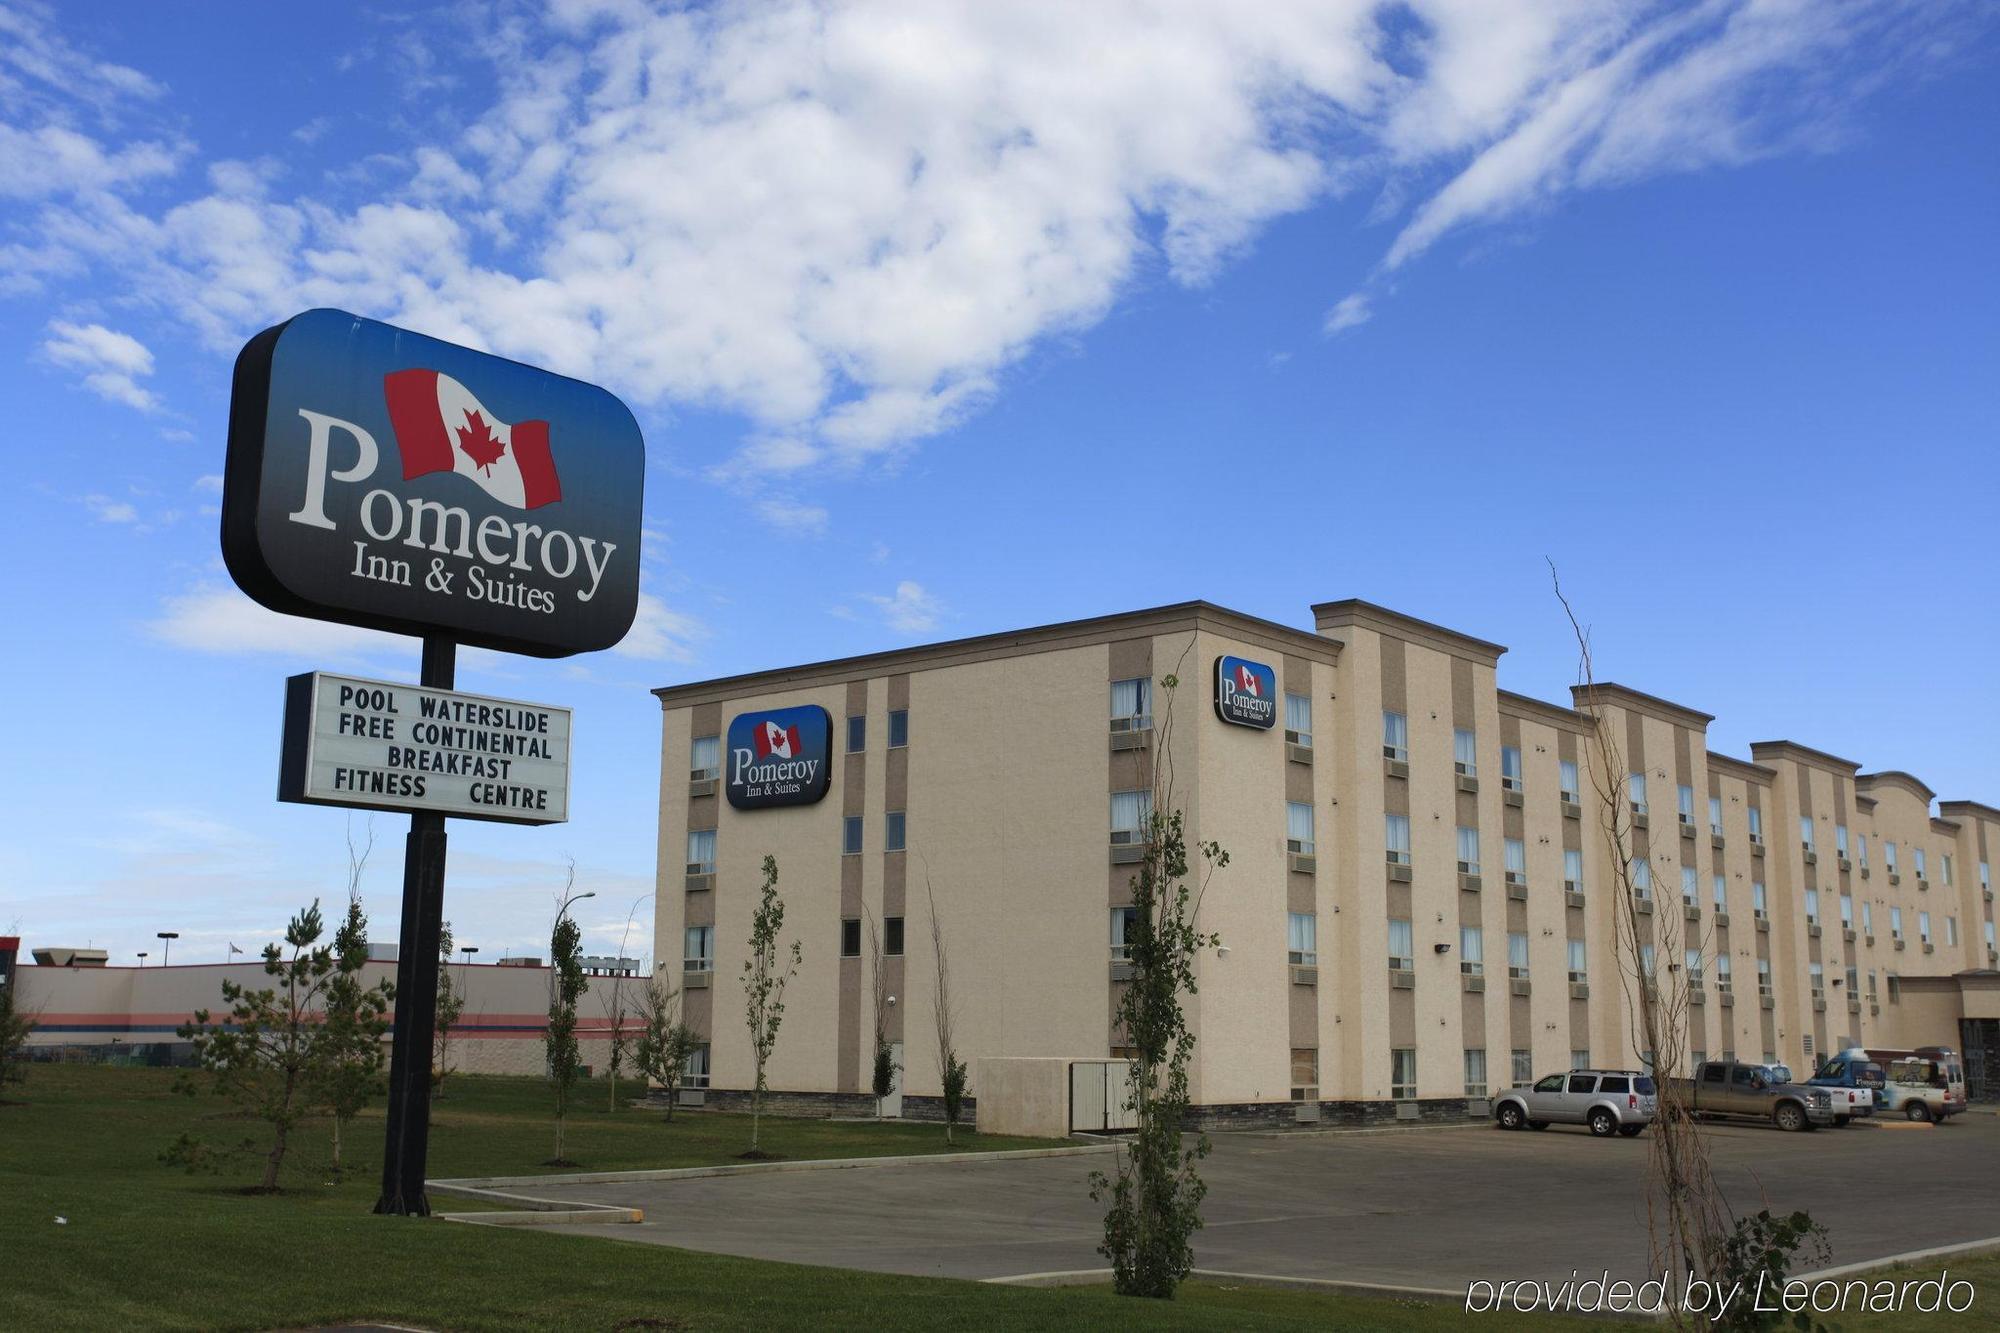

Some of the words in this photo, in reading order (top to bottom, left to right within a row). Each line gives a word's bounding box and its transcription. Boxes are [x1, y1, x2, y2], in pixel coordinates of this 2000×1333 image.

[288, 408, 618, 602] Pomeroy
[351, 540, 412, 586] Inn
[424, 557, 453, 595] &
[465, 565, 556, 614] Suites
[340, 685, 399, 714] POOL
[419, 696, 549, 734] WATERSLIDE
[1223, 678, 1272, 718] Pomeroy
[339, 713, 395, 740] FREE
[412, 722, 552, 760] CONTINENTAL
[387, 745, 512, 780] BREAKFAST
[732, 748, 819, 786] Pomeroy
[334, 767, 427, 798] FITNESS
[469, 782, 548, 811] CENTRE
[746, 784, 762, 797] Inn
[764, 783, 772, 795] &
[774, 781, 801, 795] Suites
